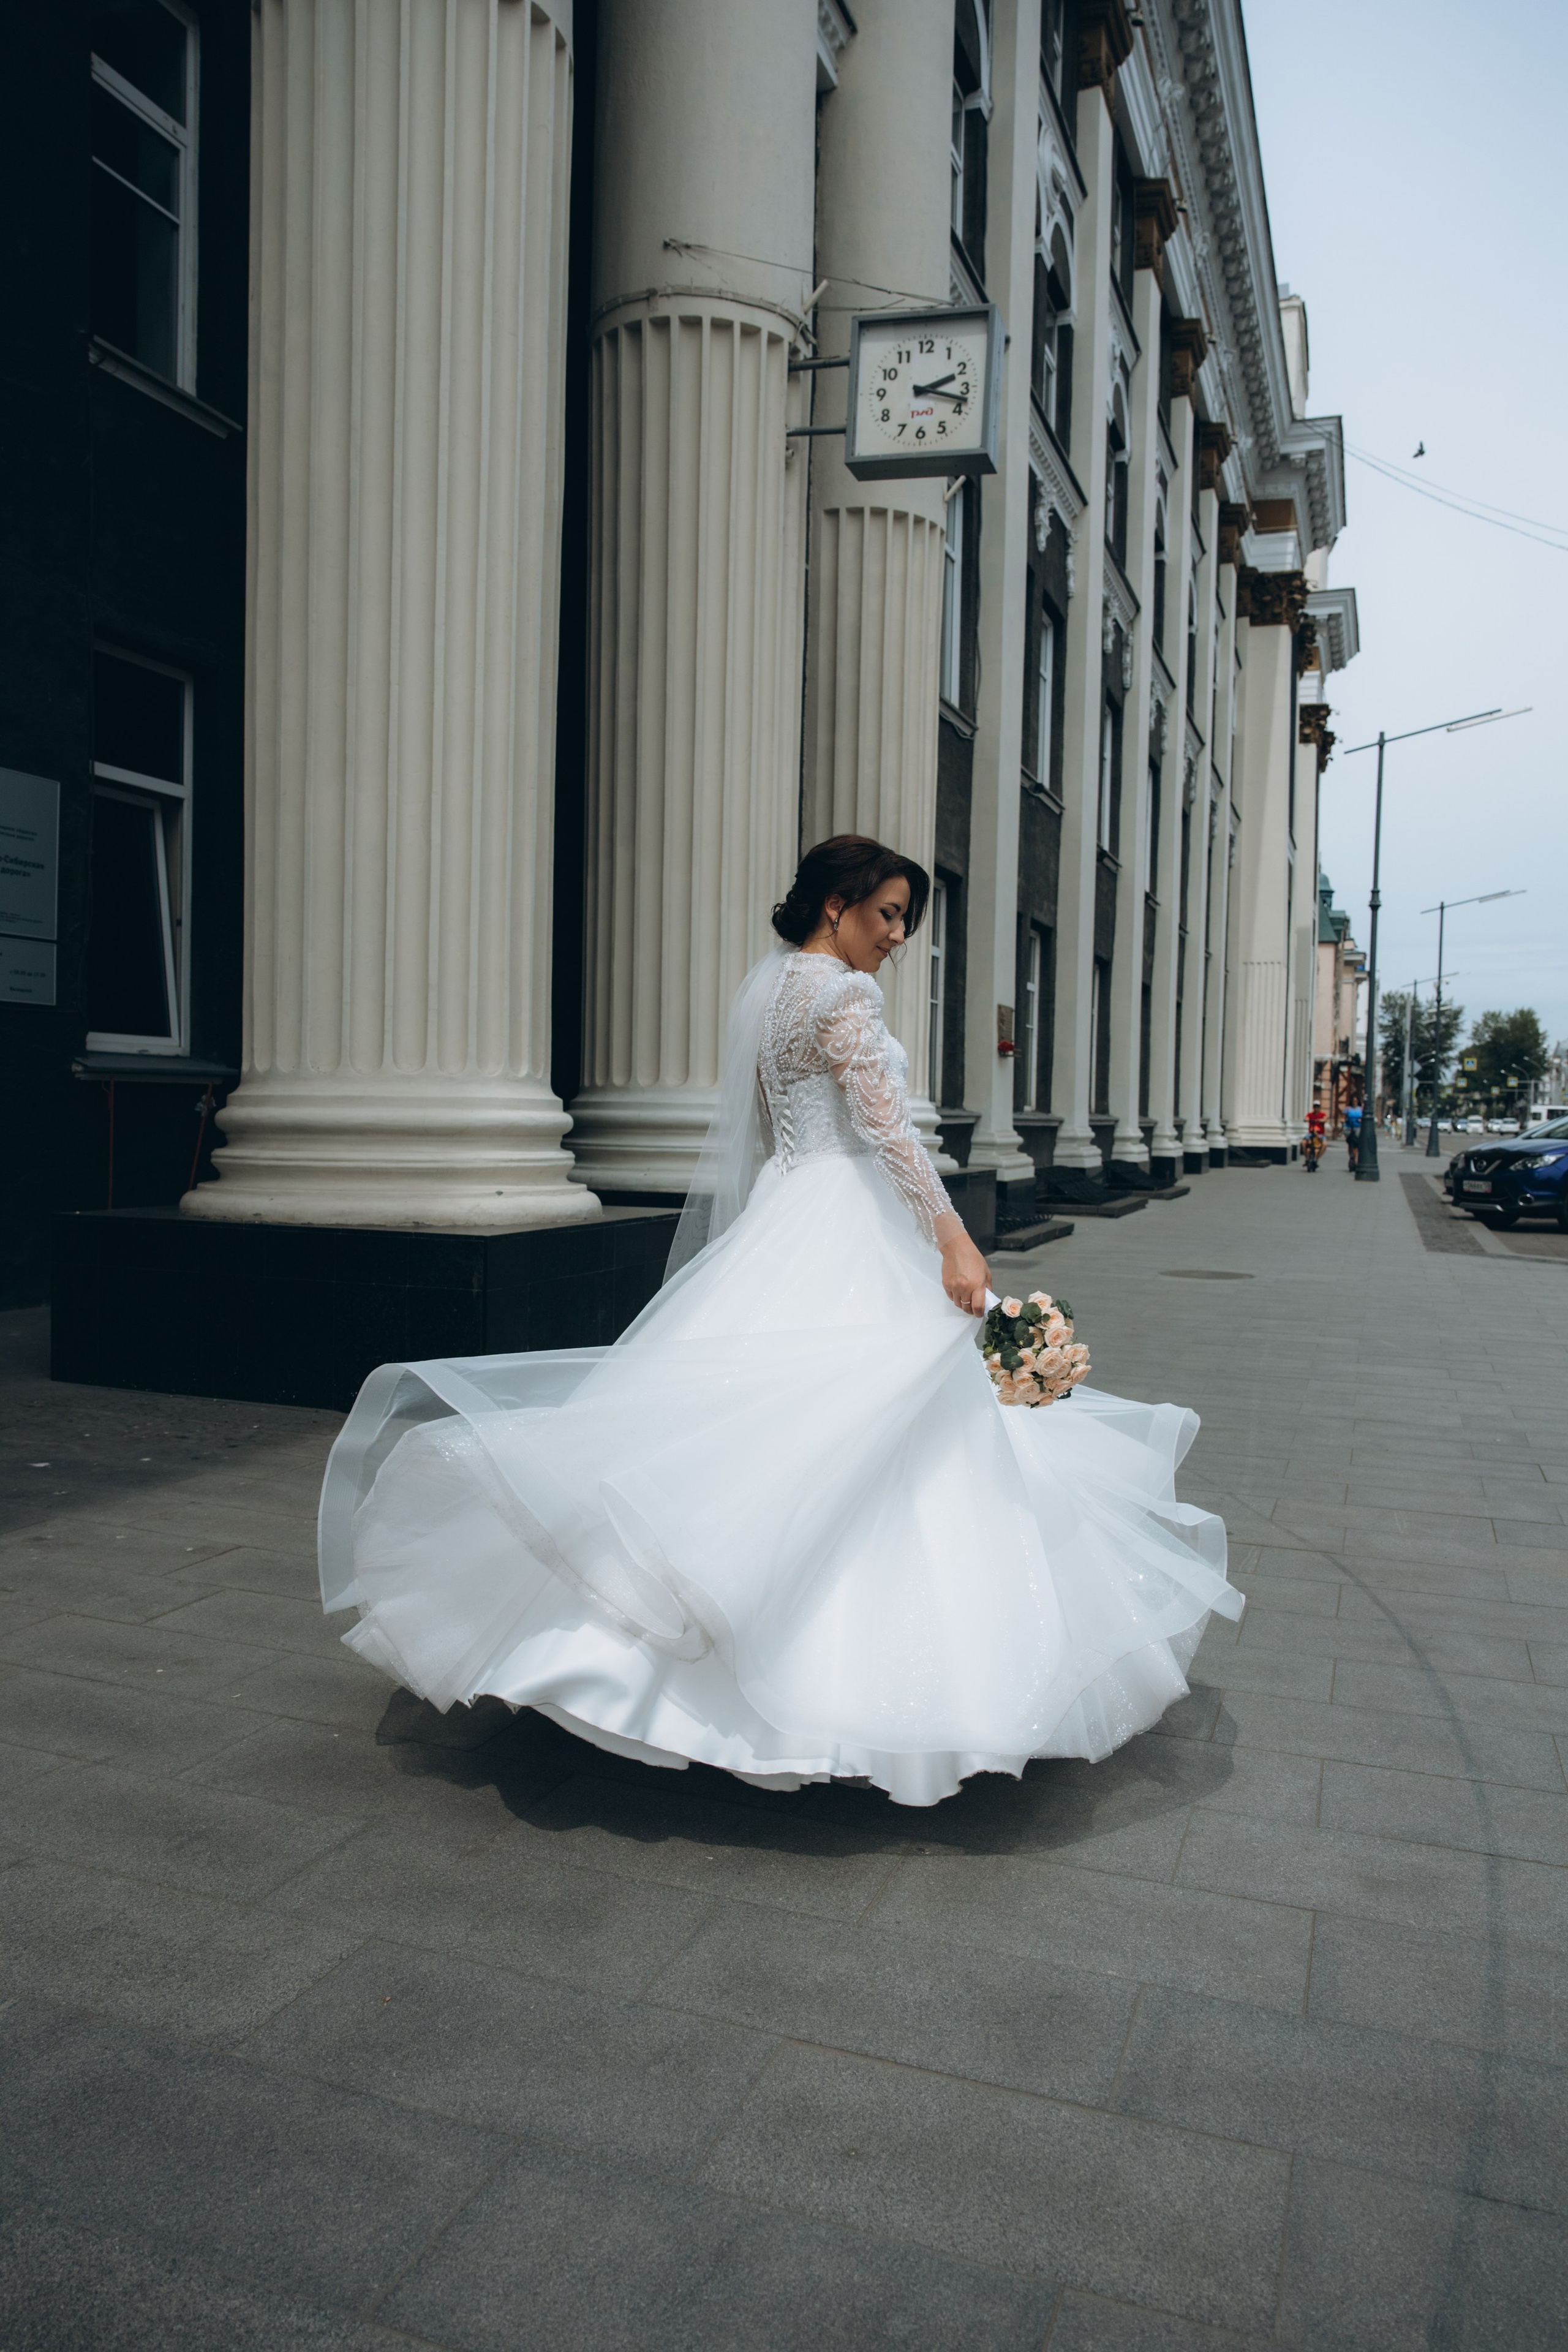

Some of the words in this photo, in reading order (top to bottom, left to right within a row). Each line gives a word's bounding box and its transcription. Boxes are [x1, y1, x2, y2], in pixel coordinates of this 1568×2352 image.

[918, 339, 935, 353] 12
[897, 350, 911, 364] 11
[946, 347, 951, 360] 1
[882, 368, 898, 381] 10
[957, 361, 967, 375] 2
[876, 388, 887, 401] 9
[960, 382, 970, 396] 3
[881, 409, 890, 422] 8
[952, 402, 963, 416] 4
[897, 423, 907, 437] 7
[915, 426, 926, 440] 6
[937, 421, 946, 434] 5
